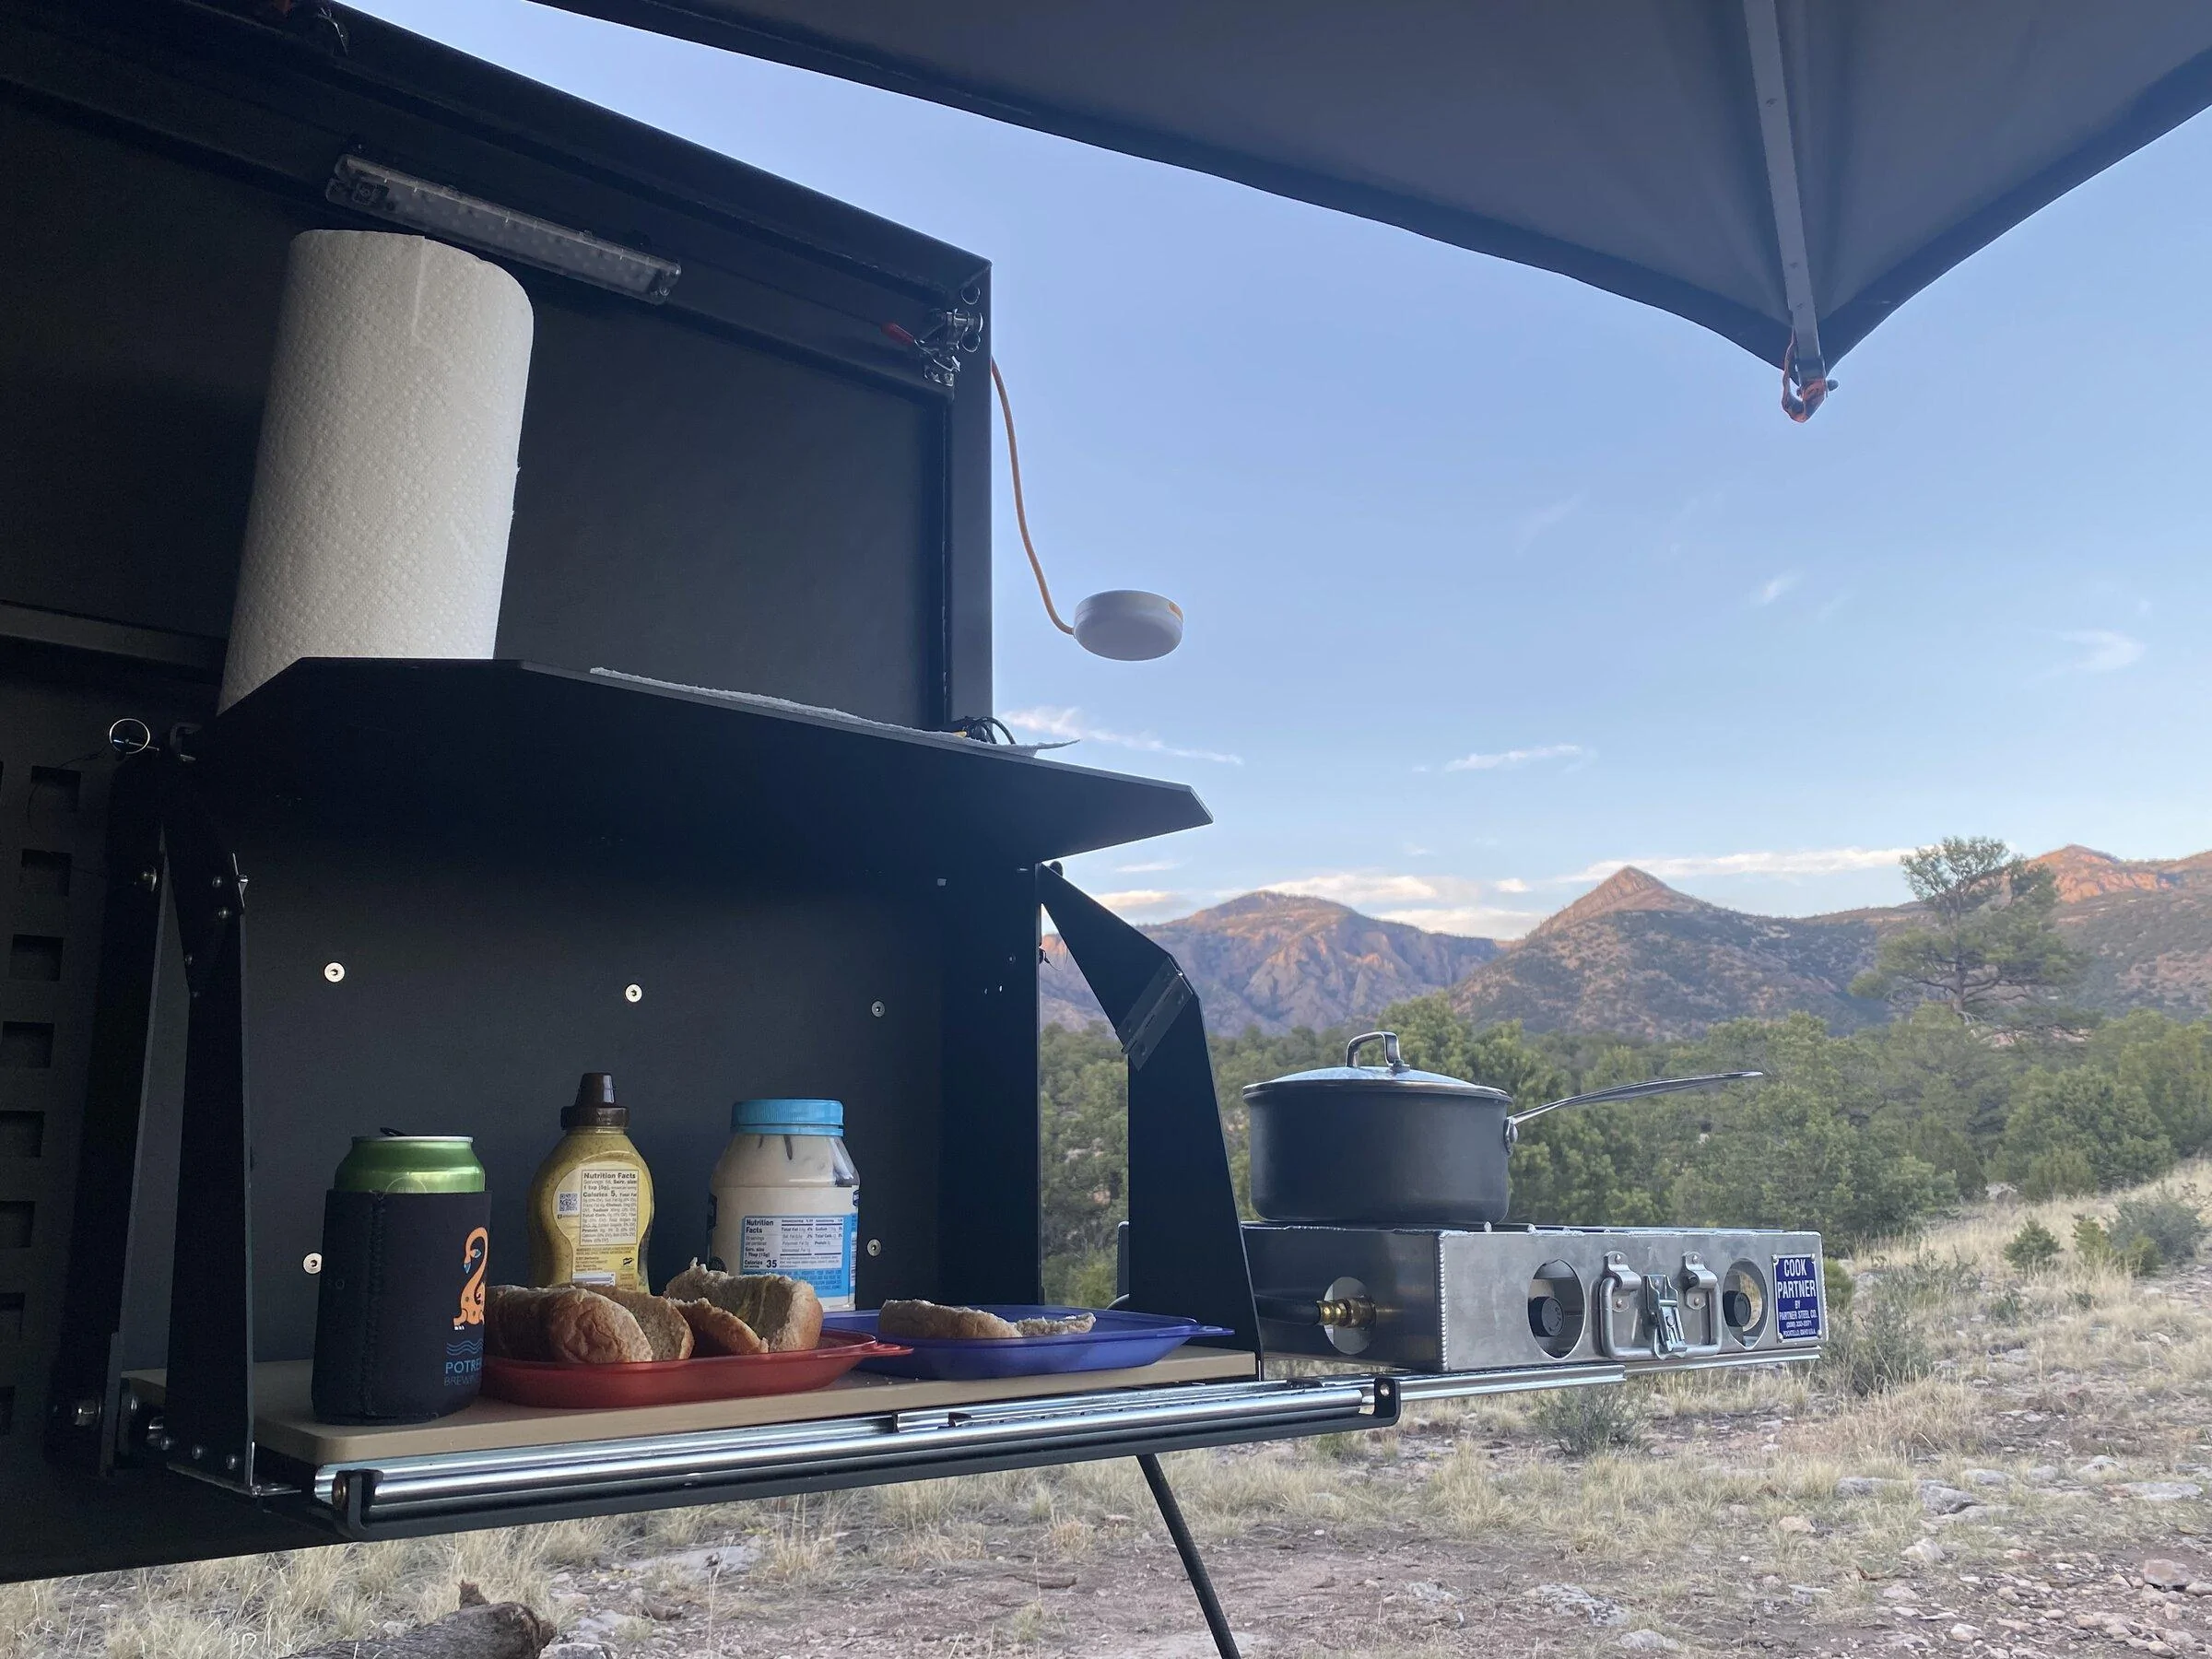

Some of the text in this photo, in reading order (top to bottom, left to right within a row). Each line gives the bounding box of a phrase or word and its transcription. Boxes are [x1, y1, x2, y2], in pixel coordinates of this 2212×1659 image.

[766, 1259, 777, 1268] 35
[1783, 1259, 1806, 1277] COOK
[1777, 1279, 1817, 1299] PARTNER
[1794, 1300, 1801, 1309] BY
[1779, 1311, 1797, 1321] PARTNER
[1797, 1310, 1810, 1320] STEEL
[446, 1358, 482, 1374] POTRE
